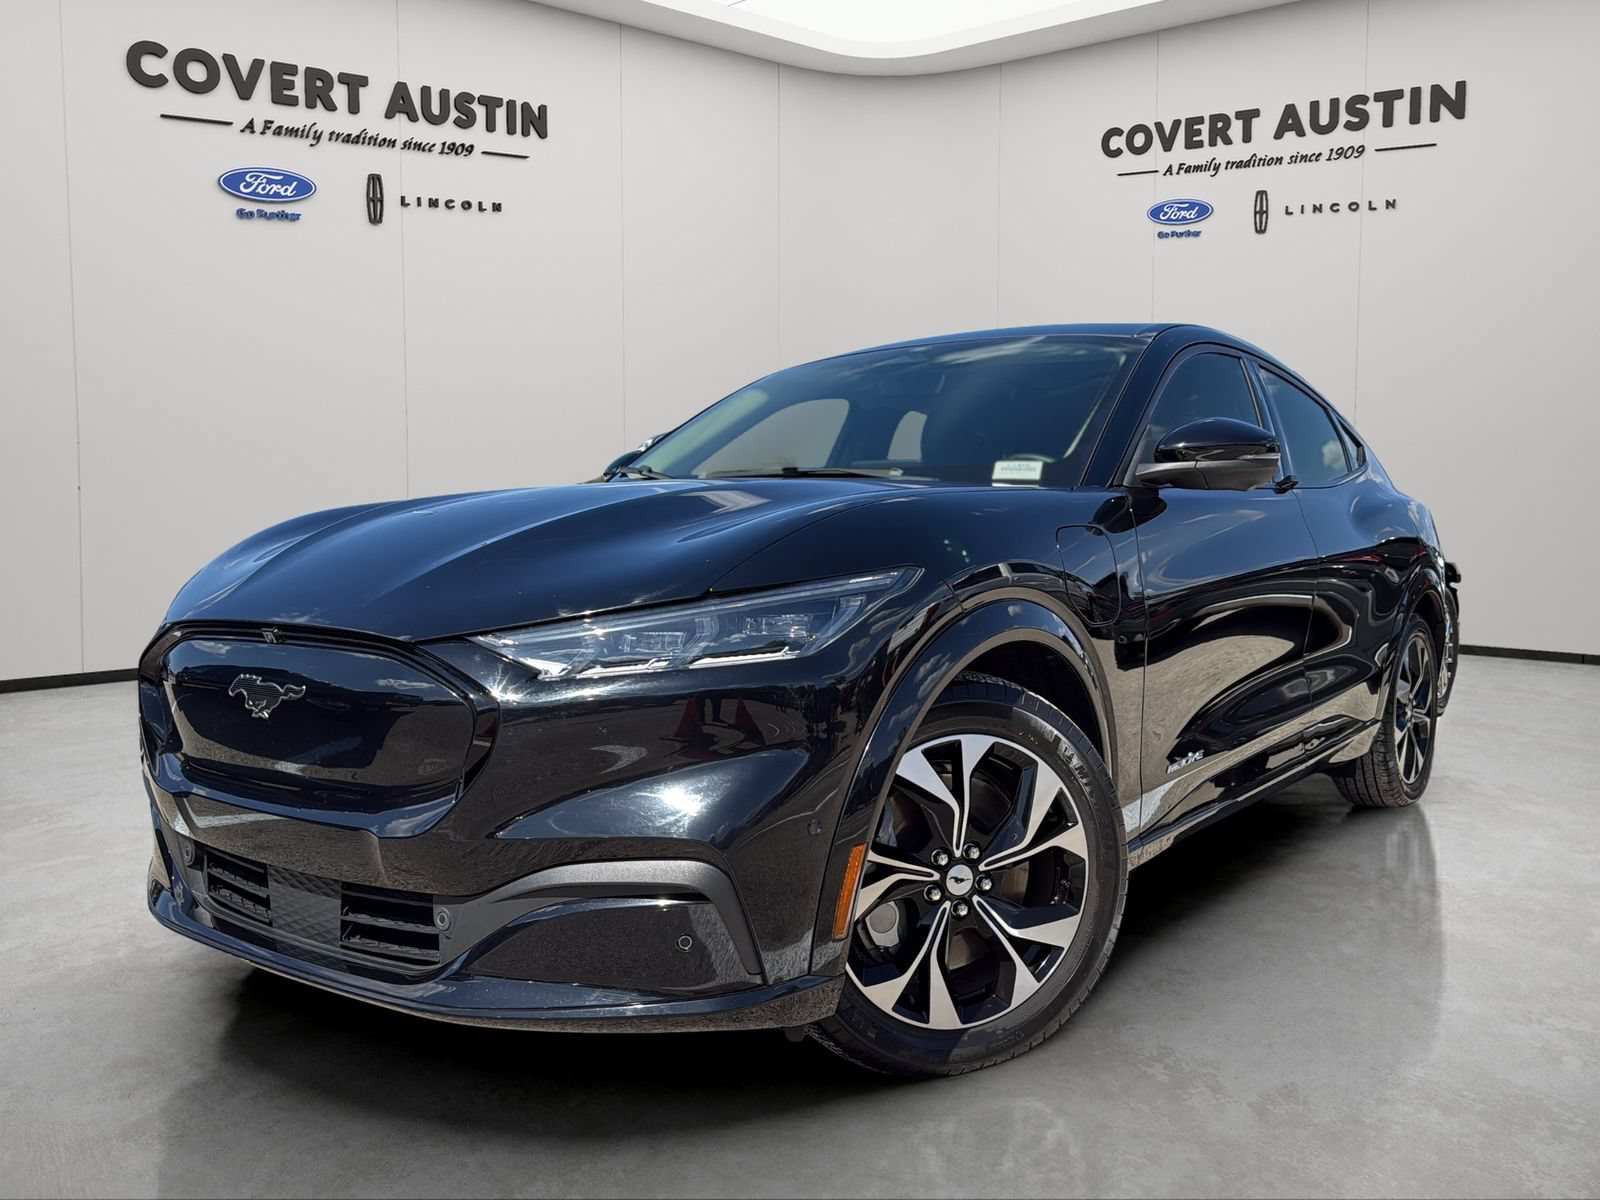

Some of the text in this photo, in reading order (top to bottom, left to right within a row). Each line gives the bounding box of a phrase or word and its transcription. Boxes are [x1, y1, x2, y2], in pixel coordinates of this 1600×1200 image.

[126, 40, 548, 140] COVERT AUSTIN
[1100, 80, 1467, 159] COVERT AUSTIN
[240, 118, 475, 158] A Family tradition since 1909
[1162, 145, 1366, 178] A Family tradition since 1909
[240, 171, 298, 197] Ford
[400, 195, 503, 213] LINCOLN
[1160, 203, 1199, 220] Ford
[1284, 198, 1398, 216] LINCOLN
